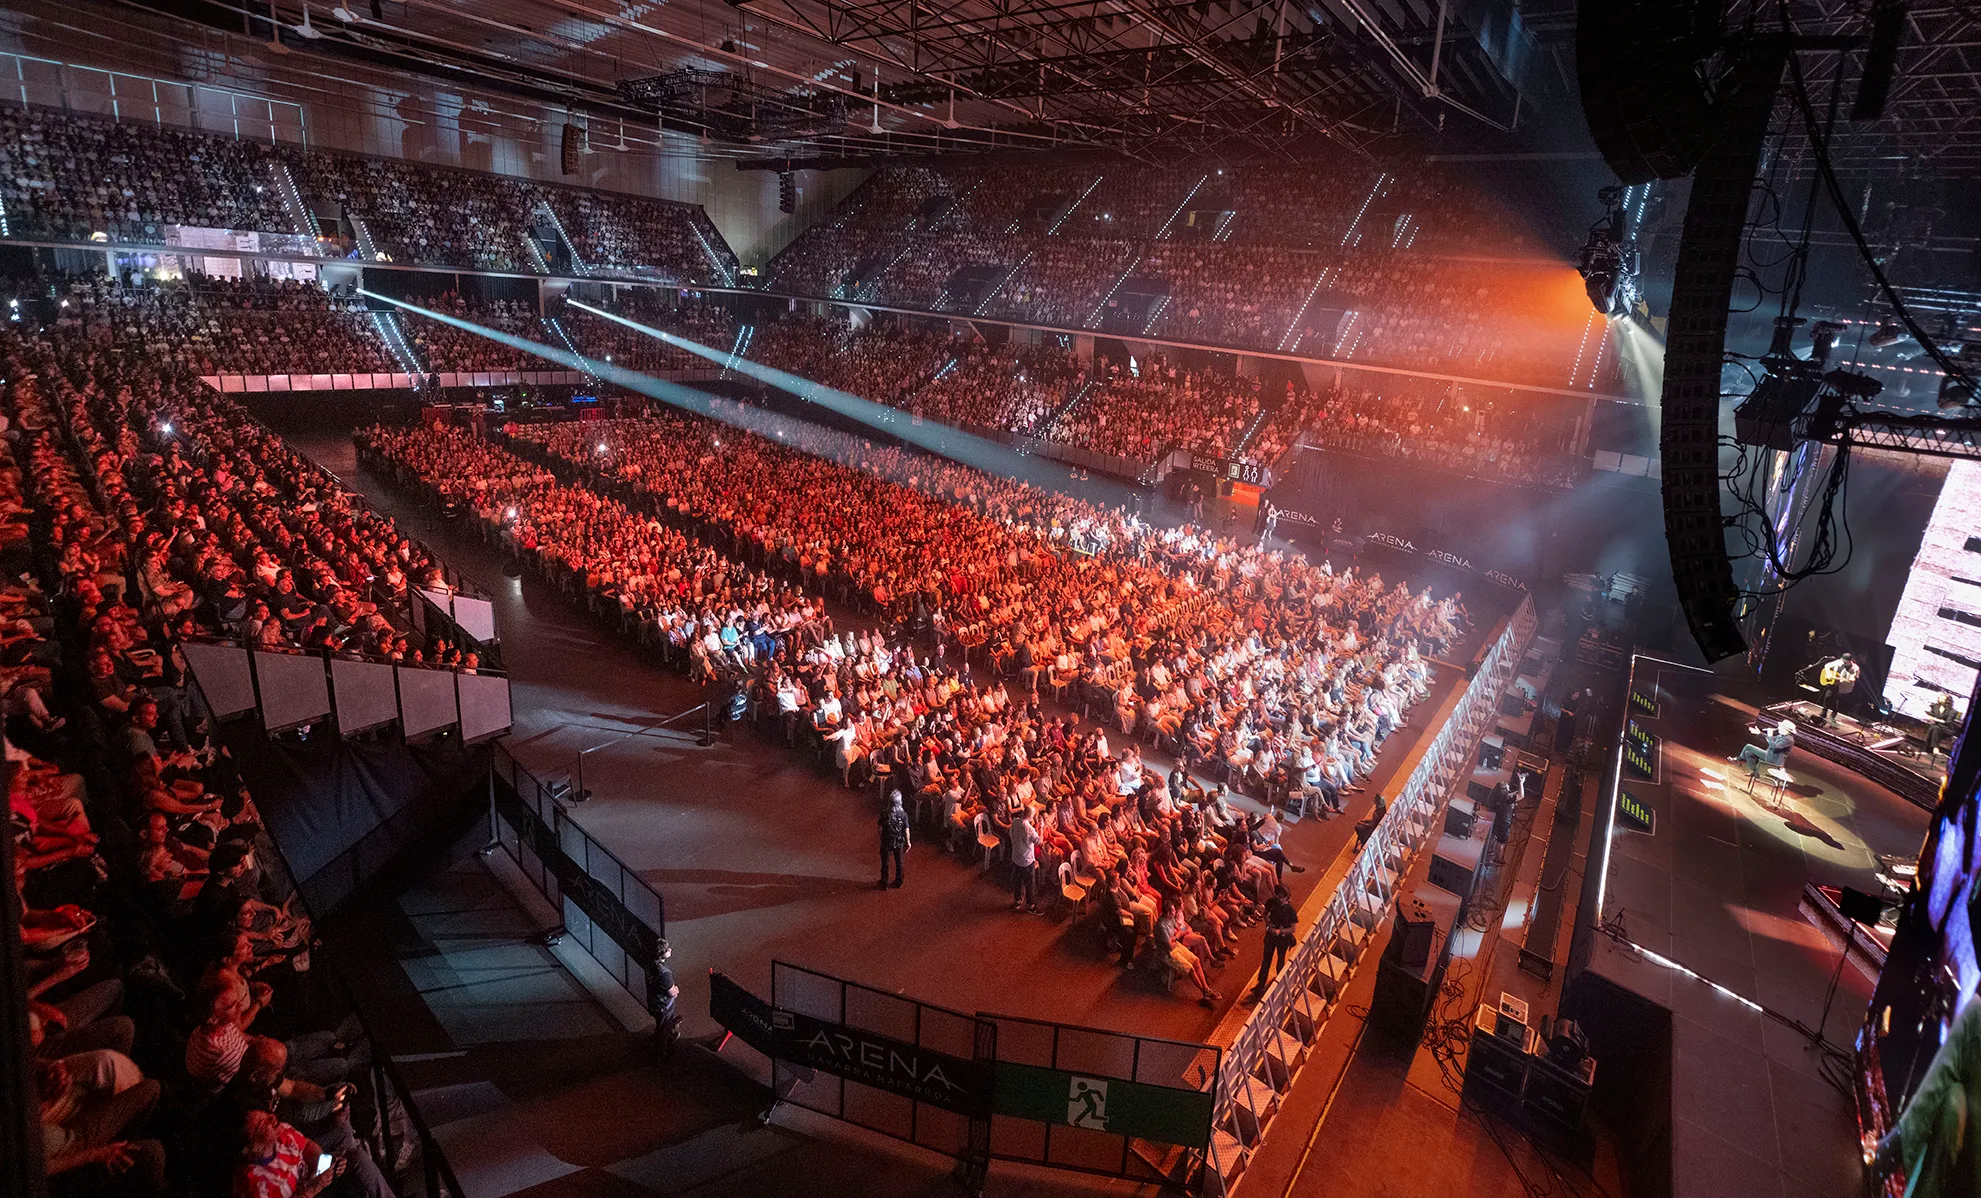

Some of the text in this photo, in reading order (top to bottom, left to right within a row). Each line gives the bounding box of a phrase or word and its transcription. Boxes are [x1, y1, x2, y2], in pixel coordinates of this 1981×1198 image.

[1192, 462, 1219, 473] IRTEERA
[1193, 455, 1216, 466] SALIDA
[1276, 509, 1319, 525] ARENA
[1368, 532, 1417, 551] ARENA
[1426, 549, 1475, 570] ARENA
[1484, 569, 1528, 591] ARENA
[567, 873, 645, 950] ARENA
[741, 1008, 773, 1035] ARENA
[797, 1029, 966, 1095] ARENA
[877, 1074, 952, 1103] NAFARROA
